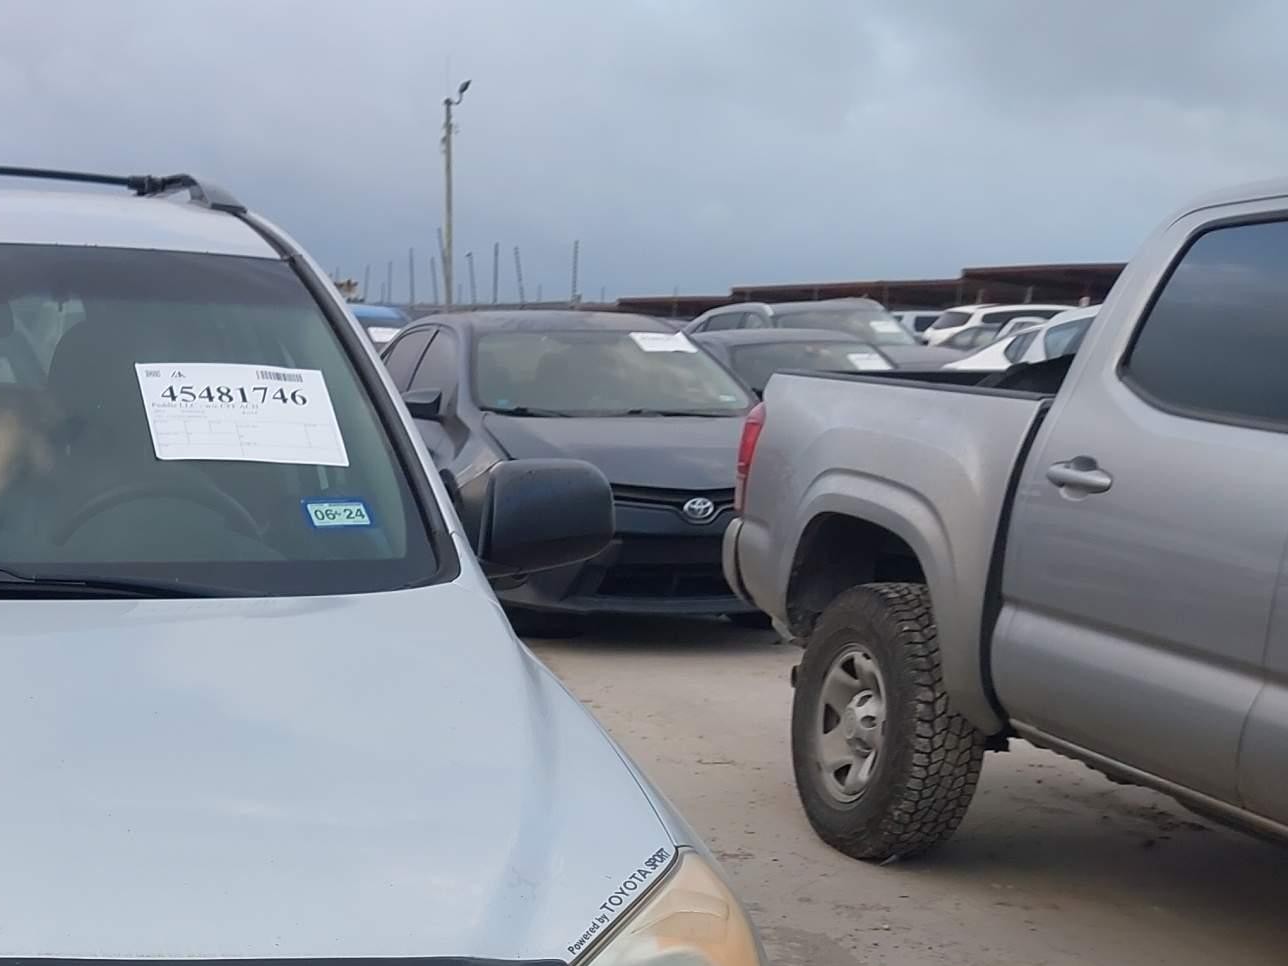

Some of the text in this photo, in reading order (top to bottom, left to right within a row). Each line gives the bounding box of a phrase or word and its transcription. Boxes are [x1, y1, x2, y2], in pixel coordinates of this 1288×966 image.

[160, 385, 308, 406] 45481746
[567, 847, 671, 955] Powered by TOYOTA SPORT
